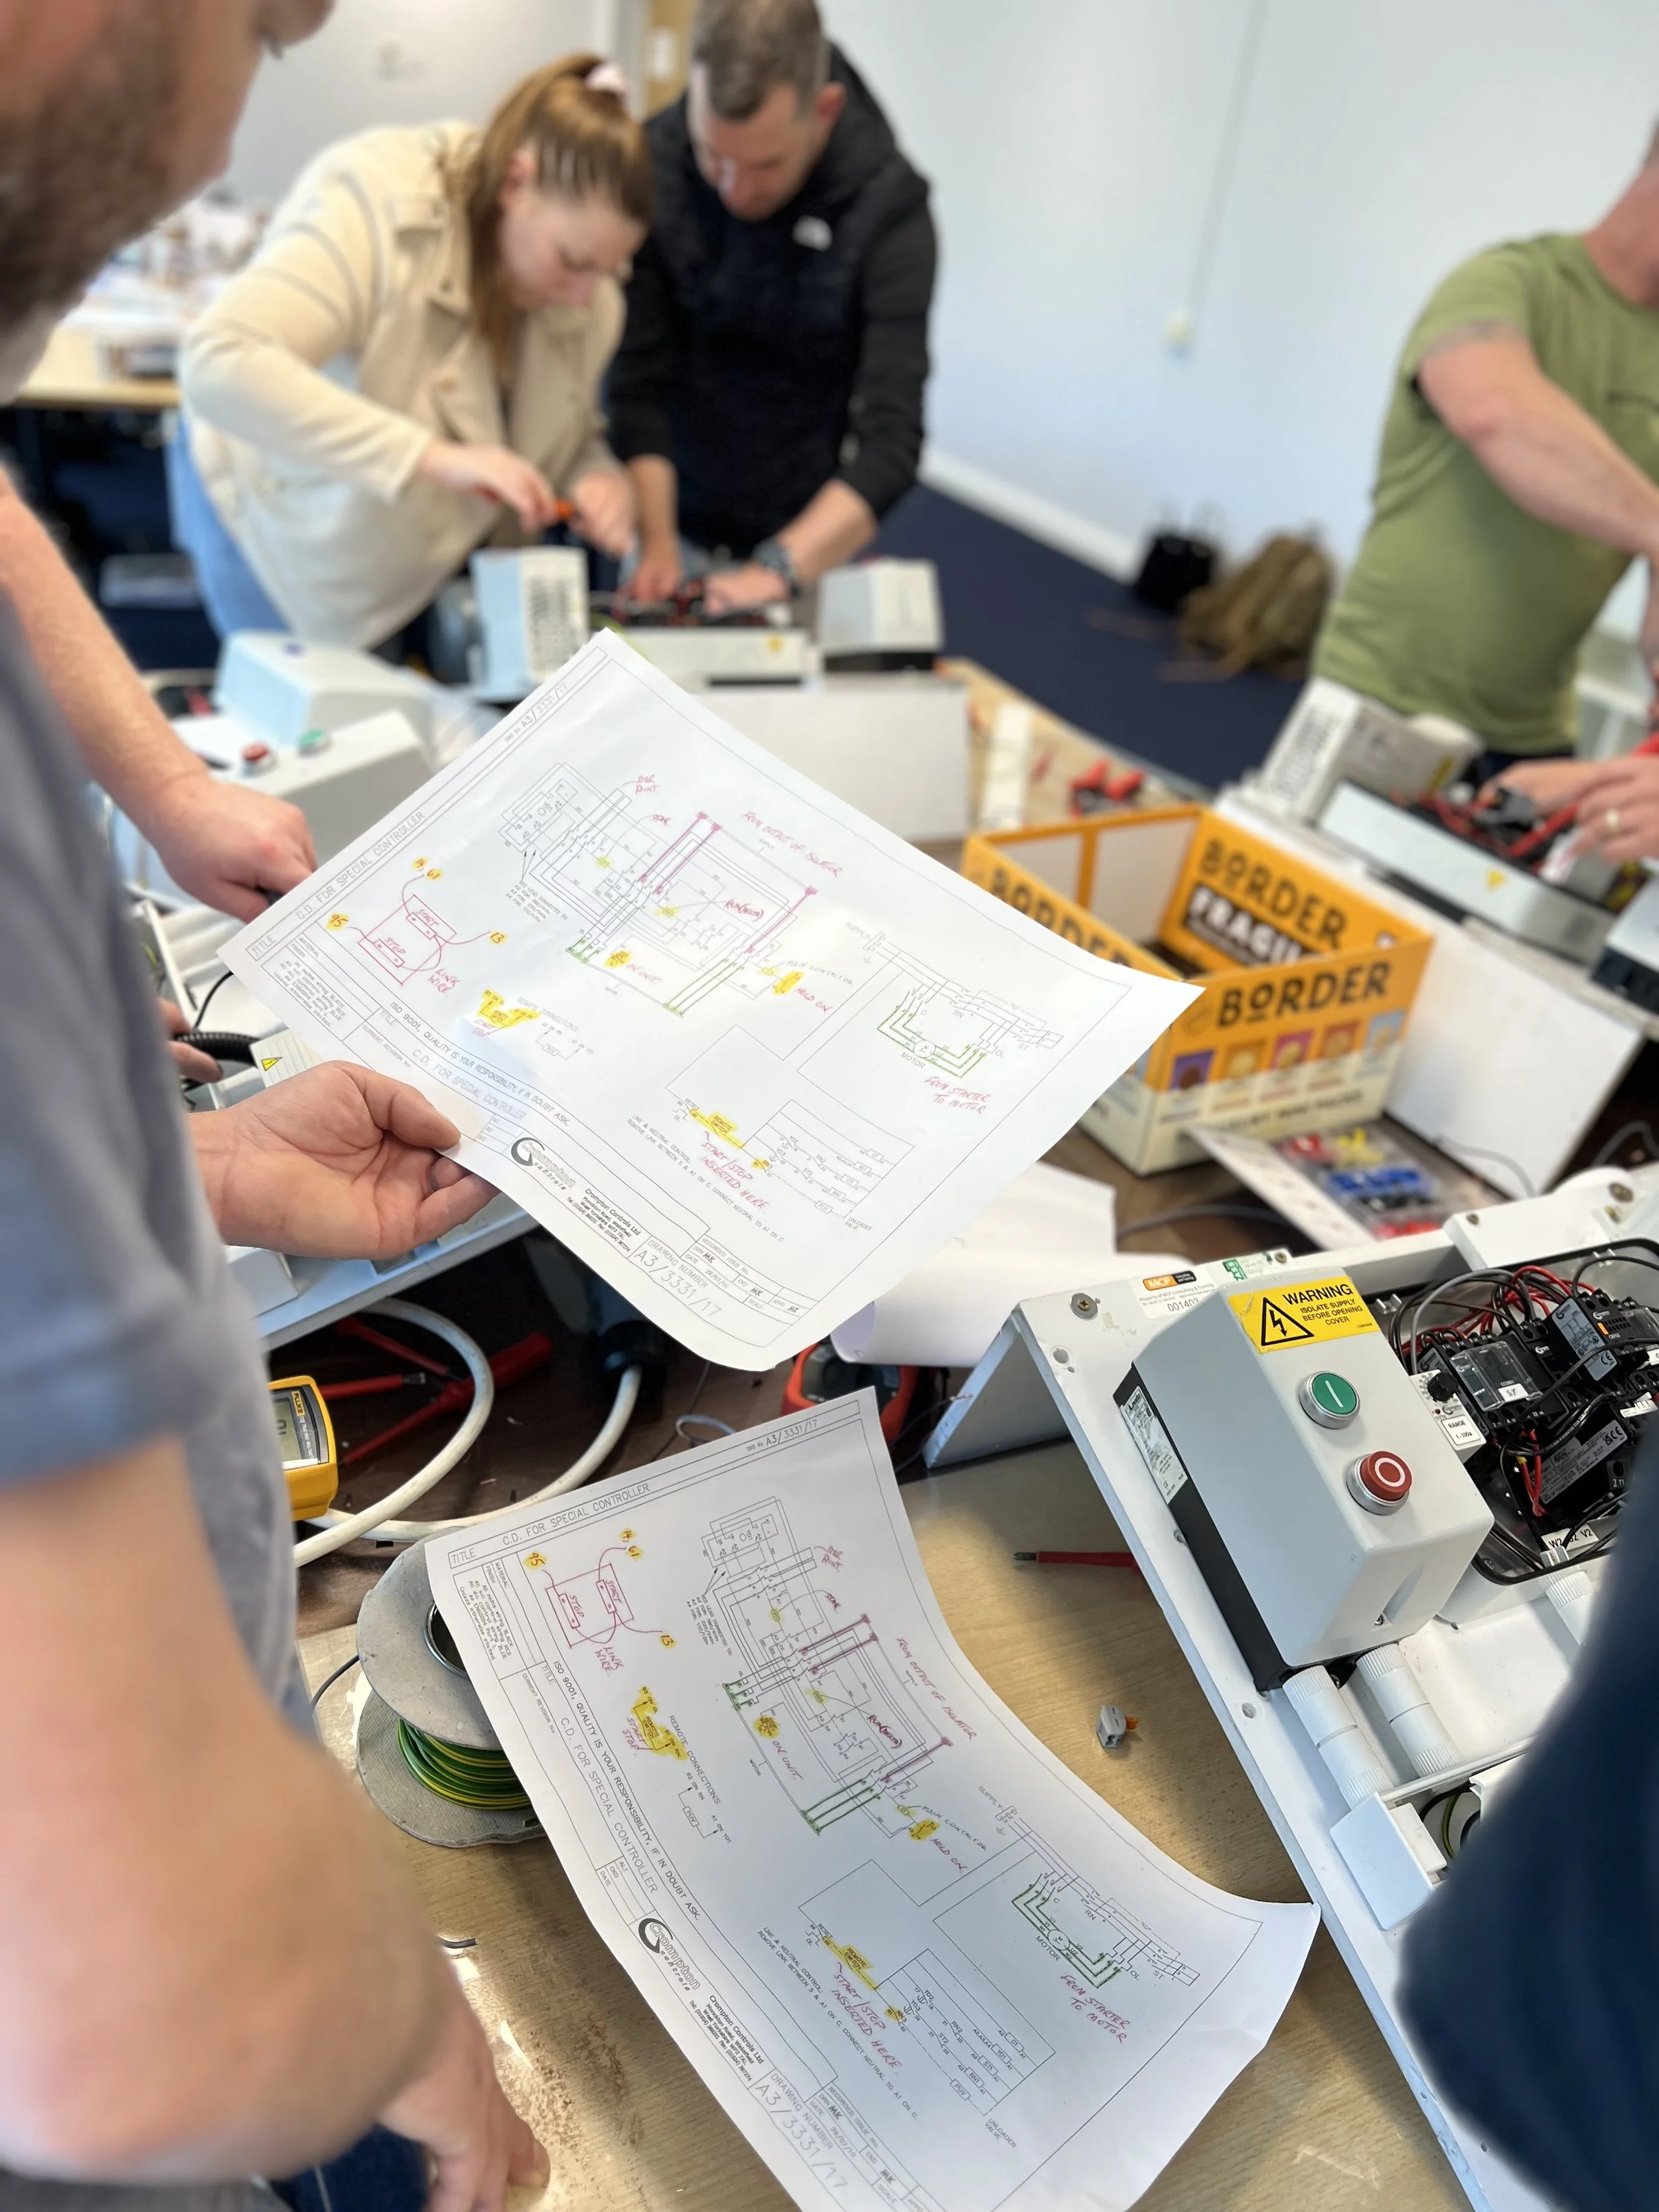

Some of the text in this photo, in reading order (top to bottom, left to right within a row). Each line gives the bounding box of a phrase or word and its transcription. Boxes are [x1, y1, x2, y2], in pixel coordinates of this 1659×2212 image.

[252, 934, 276, 956] TITLE
[296, 903, 317, 920] C.D.
[316, 885, 336, 903] FOR
[336, 857, 373, 887] SPECIAL
[374, 810, 425, 857] CONTROLLER
[1200, 838, 1347, 949] BORDER
[331, 915, 349, 927] 95
[415, 909, 439, 926] START
[385, 937, 406, 954] STOP
[1217, 962, 1392, 1028] BORDER
[379, 1009, 398, 1027] TITLE
[390, 1001, 569, 1126] ISO 9001, QUALITY IS YOUR RESPONSIBILITY, DOUBT ASK.
[900, 1051, 926, 1070] MOTOR
[433, 1064, 452, 1080] FOR
[452, 1075, 482, 1097] SPECIAL
[484, 1093, 526, 1121] CONTROLLER
[934, 1094, 950, 1104] TO
[948, 1087, 991, 1104] STARTER
[522, 1141, 576, 1188] Crompton
[699, 1157, 741, 1189] INSERTED
[585, 1188, 642, 1236] Crompton Controls Ltd
[647, 1238, 709, 1289] DRAWING NUMBER
[634, 1250, 723, 1317] A3/3331/17
[1148, 1278, 1171, 1288] MCP
[1282, 1284, 1353, 1305] WARNING
[1300, 1298, 1355, 1313] ISOLATE SUPPLY
[1303, 1305, 1363, 1321] BEFORE OPENING
[1325, 1315, 1350, 1326] COVER
[294, 1392, 303, 1414] FLUKE
[1506, 1386, 1516, 1396] ST
[746, 1419, 818, 1452] DRG A3/3331/17
[1448, 1419, 1467, 1429] RANGE
[452, 1483, 650, 1564] TITLE C.D. FOR SPECIAL CONTROLLER
[1548, 1537, 1563, 1548] W2
[1580, 1528, 1593, 1538] V2
[529, 1552, 545, 1567] 95
[486, 1565, 496, 1584] FINISH
[495, 1562, 510, 1589] MATERIAL
[605, 1580, 622, 1604] START
[460, 1587, 485, 1637] Unless otherwise
[569, 1595, 585, 1619] STOP
[478, 1601, 508, 1660] control BLUE
[484, 1601, 512, 1656] control RED
[503, 1629, 514, 1647] BLACK
[660, 1633, 674, 1646] 13
[595, 1650, 615, 1671] WIRE
[603, 1646, 624, 1670] LINK
[541, 1664, 556, 1685] TITLE
[522, 1672, 552, 1724] CURRENT REVISION
[932, 1690, 946, 1702] OF
[668, 1714, 721, 1806] REMOTE CONNECTIONS
[553, 1660, 700, 1921] ISO 9001, QUALITY IS YOUR RESPONSIBILITY, IF IN DOUBT ASK.
[977, 1785, 1003, 1808] SUPPLY
[561, 1717, 658, 1894] C.D. FOR SPECIAL CONTROLLER
[922, 1805, 987, 1852] MAIN CONTACTOR
[930, 1836, 951, 1856] HOLD
[1084, 1909, 1097, 1921] RN
[650, 1922, 701, 1990] Crompton
[762, 1926, 776, 1939] LINE
[779, 1945, 802, 1968] NEUTRAL
[847, 1947, 868, 1968] REMOTE
[1035, 1935, 1060, 1961] MOTOR
[843, 1951, 863, 1971] SWITCH
[757, 1930, 885, 2081] REMOVE LINK BETWEEN CONNECT NEUTRAL
[1060, 1974, 1130, 2030] FROM STARTER
[702, 2008, 731, 2045] West Yorkshire
[709, 1994, 765, 2065] Crompton Controls Ltd
[831, 1990, 902, 2068] INSERTED HERE
[951, 2020, 964, 2033] RN2
[1070, 1996, 1128, 2044] TO MOTOR
[938, 2032, 950, 2045] ST2
[734, 2039, 755, 2065] Wakefield
[954, 2083, 967, 2097] PUV
[769, 2073, 834, 2150] DRAWING NUMBER
[809, 2099, 825, 2117] DATE
[828, 2086, 871, 2136] RECORDED ISSUE
[755, 2083, 848, 2189] A3/3331/17
[985, 2122, 1002, 2141] VALVE
[988, 2117, 1017, 2149] UNLOADER
